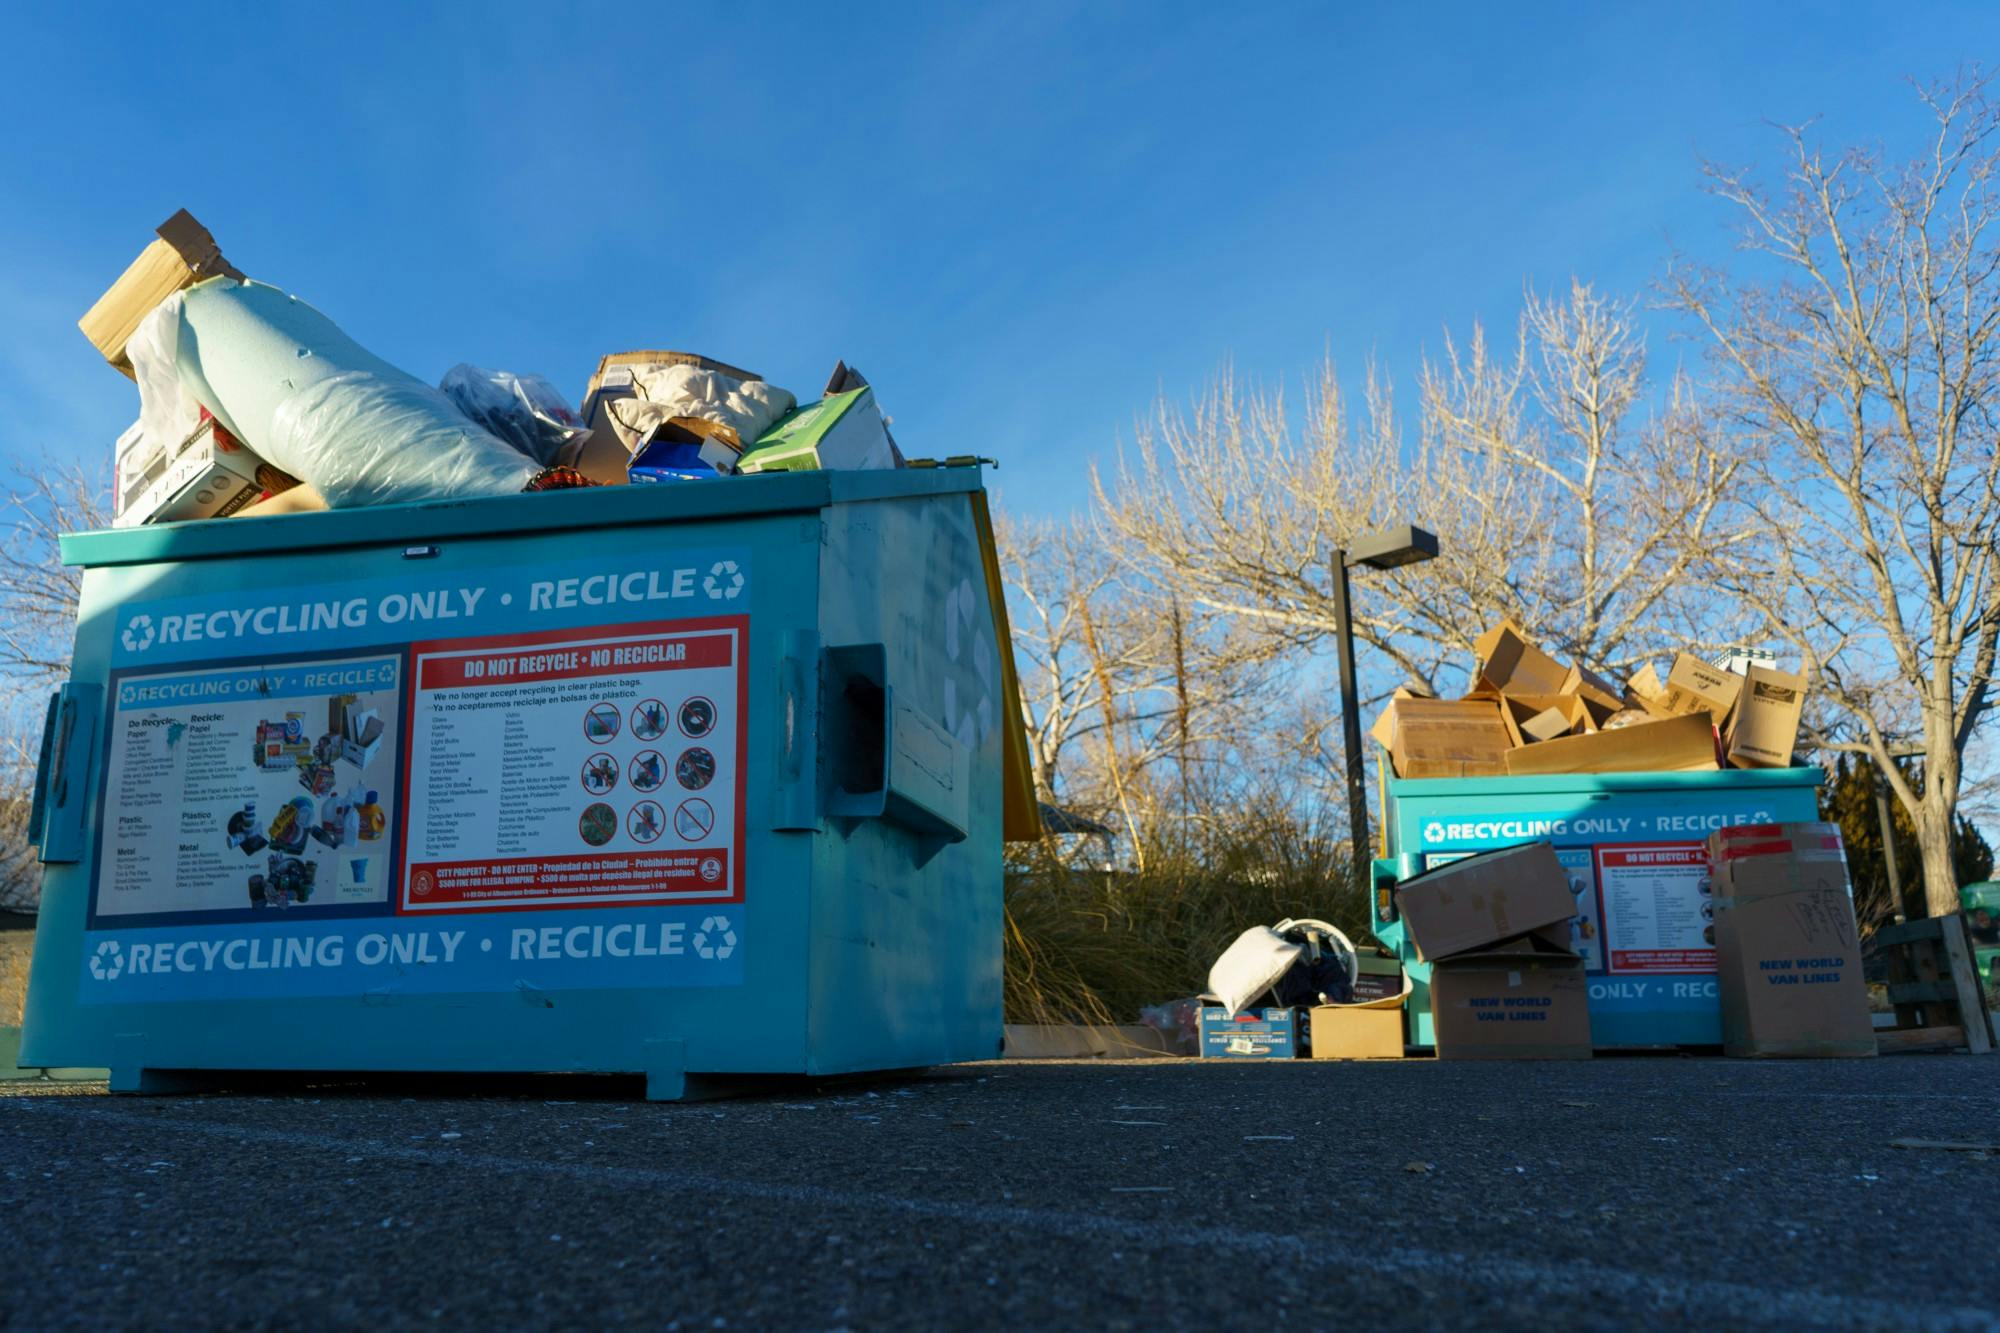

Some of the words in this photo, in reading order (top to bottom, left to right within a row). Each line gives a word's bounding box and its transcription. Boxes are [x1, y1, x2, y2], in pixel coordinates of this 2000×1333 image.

[158, 598, 368, 644] RECYCLING
[378, 587, 486, 624] ONLY
[529, 568, 697, 612] RECICLE
[463, 659, 484, 678] DO
[487, 657, 516, 676] NOT
[519, 652, 578, 674] RECYCLE
[590, 649, 610, 668] NO
[614, 643, 685, 666] RECICLAR
[137, 680, 231, 702] RECYCLING
[235, 678, 284, 694] ONLY
[304, 668, 375, 688] RECICLE
[433, 692, 447, 702] We
[448, 691, 460, 701] no
[461, 689, 487, 700] longer
[489, 687, 517, 698] accept
[519, 684, 556, 696] recycling
[557, 683, 565, 693] in
[567, 682, 587, 692] clear
[590, 679, 617, 691] plastic
[620, 678, 642, 689] bags.
[432, 704, 443, 712] Ya
[445, 703, 456, 711] no
[457, 699, 512, 710] aceptaremos
[513, 696, 546, 706] reciclaje
[549, 695, 558, 704] en
[561, 693, 587, 703] bolsas
[589, 692, 600, 701] de
[602, 689, 638, 700] plástico.
[128, 720, 141, 728] Do
[191, 713, 225, 722] Recicle:
[127, 730, 147, 739] Paper
[189, 725, 211, 734] Papel
[119, 816, 143, 825] Plastic
[182, 811, 212, 820] Plástico
[1446, 820, 1567, 841] RECYCLING
[1573, 817, 1630, 835] ONLY
[1656, 813, 1747, 832] RECICLE
[117, 848, 136, 857] Metal
[179, 843, 199, 852] Metal
[1626, 854, 1637, 863] DO
[1639, 853, 1654, 862] NOT
[1656, 852, 1690, 862] RECYCLE
[436, 867, 451, 876] CITY
[453, 866, 486, 876] PROPERTY
[491, 865, 501, 874] DO
[502, 864, 515, 873] NOT
[517, 863, 537, 873] ENTER
[543, 862, 580, 872] Propiedad
[582, 861, 591, 870] de
[593, 861, 600, 869] la
[601, 859, 627, 869] Ciudad
[635, 857, 672, 867] Prohibido
[674, 856, 698, 866] entrar
[438, 878, 455, 887] $500
[456, 878, 468, 887] FINE
[469, 877, 480, 886] FOR
[482, 876, 504, 886] ILLEGAL
[505, 875, 534, 885] DUMPING
[540, 874, 557, 883] $500
[559, 873, 567, 882] de
[589, 872, 600, 881] por
[654, 869, 662, 878] de
[128, 933, 345, 975] RECYCLING
[354, 931, 466, 965] ONLY
[510, 923, 685, 961] RECICLE
[1759, 959, 1792, 970] NEW
[1796, 957, 1845, 970] WORLD
[1768, 974, 1799, 985] VAN
[1803, 972, 1840, 984] LINES
[1588, 983, 1648, 1000] ONLY
[1470, 997, 1500, 1007] NEW
[1504, 997, 1552, 1007] WORLD
[1477, 1011, 1505, 1021] VAN
[1509, 1011, 1547, 1021] LINES
